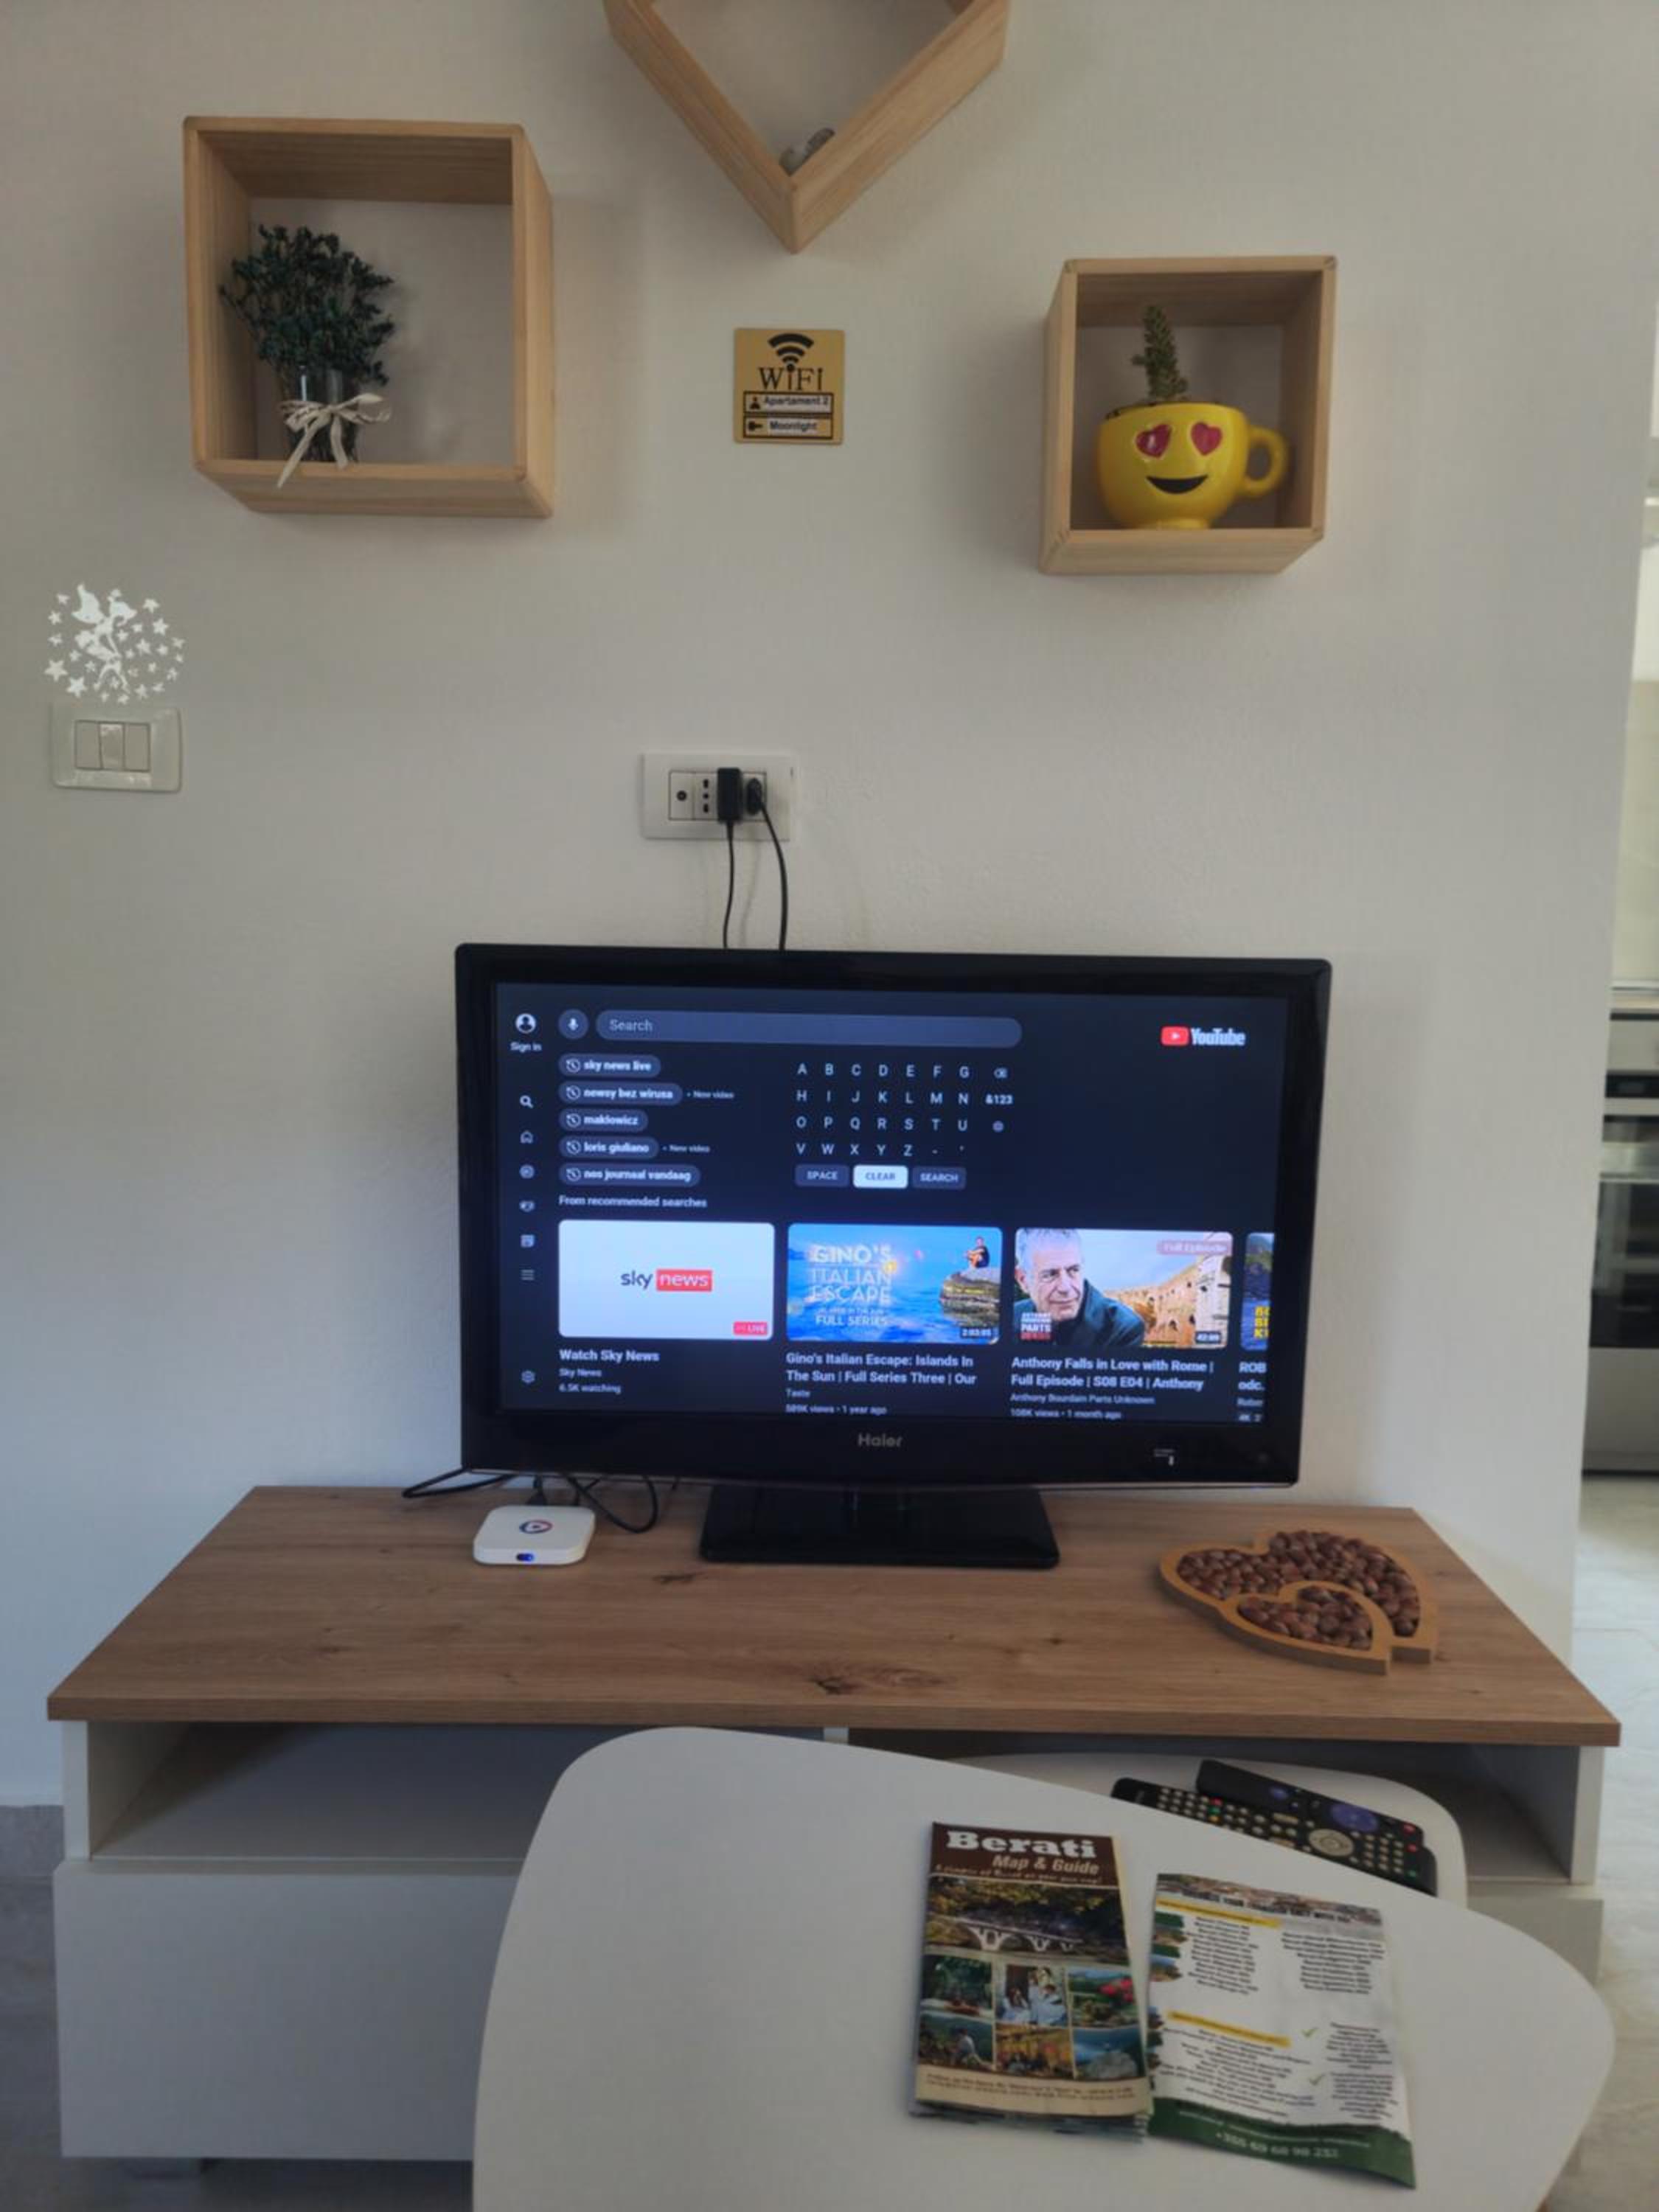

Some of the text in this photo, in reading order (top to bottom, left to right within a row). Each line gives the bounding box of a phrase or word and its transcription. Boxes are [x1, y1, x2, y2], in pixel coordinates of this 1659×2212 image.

[609, 1019, 653, 1032] Search
[1191, 1028, 1246, 1046] YouTube
[510, 1041, 542, 1053] Sign in
[583, 1060, 651, 1072] sky news live
[797, 1063, 970, 1079] A B C D E F G
[618, 1088, 637, 1098] bez
[712, 1089, 734, 1099] video
[796, 1091, 807, 1102] H
[852, 1092, 860, 1102] J
[878, 1092, 888, 1104] K
[905, 1093, 914, 1104] L
[931, 1093, 943, 1105] M
[959, 1093, 969, 1105] N
[985, 1094, 1014, 1105] &123
[796, 1117, 967, 1132] O P Q R S T U
[583, 1141, 650, 1155] loris giuliano
[669, 1144, 711, 1153] New video
[796, 1144, 806, 1155] V
[821, 1144, 834, 1155] W
[850, 1144, 860, 1155] X
[877, 1145, 886, 1156] Y
[903, 1145, 912, 1157] Z
[807, 1170, 838, 1180] SPACE
[865, 1172, 896, 1181] CLEAR
[919, 1172, 959, 1183] SEARCH
[559, 1194, 707, 1208] From recommended searches
[810, 1244, 892, 1263] GINO'S
[621, 1271, 709, 1290] sky news
[811, 1285, 892, 1306] ESCAPE
[815, 1314, 845, 1326] FULL
[559, 1349, 660, 1363] Watch Sky News
[786, 1352, 822, 1364] Gino's
[825, 1354, 863, 1365] Italian
[866, 1354, 912, 1368] Escape:
[915, 1354, 958, 1366] Islands
[1012, 1357, 1062, 1371] Anthony
[1064, 1358, 1093, 1369] Falls
[1096, 1359, 1107, 1369] in
[1110, 1359, 1141, 1371] Love
[1143, 1359, 1169, 1371] with
[1171, 1360, 1208, 1372] Rome
[559, 1368, 602, 1379] Sky News
[786, 1370, 809, 1381] The
[812, 1370, 835, 1382] Sun
[844, 1371, 867, 1382] Full
[869, 1371, 907, 1383] Series
[910, 1372, 945, 1384] Three
[954, 1373, 977, 1385] Our
[581, 1384, 621, 1394] watching
[1011, 1374, 1032, 1385] Full
[1035, 1375, 1084, 1388] Episode
[1093, 1376, 1118, 1388] S08
[1120, 1377, 1143, 1388] E04
[1152, 1378, 1203, 1391] Anthony
[809, 1405, 835, 1413] views
[849, 1406, 868, 1414] year
[869, 1407, 887, 1416] ago
[1074, 1410, 1103, 1419] month
[1105, 1411, 1121, 1420] ago
[858, 1434, 903, 1448] Haier
[947, 1831, 1096, 1858] Berati
[992, 1854, 1029, 1871] Map
[1034, 1857, 1047, 1871] &
[1052, 1859, 1099, 1876] Guide
